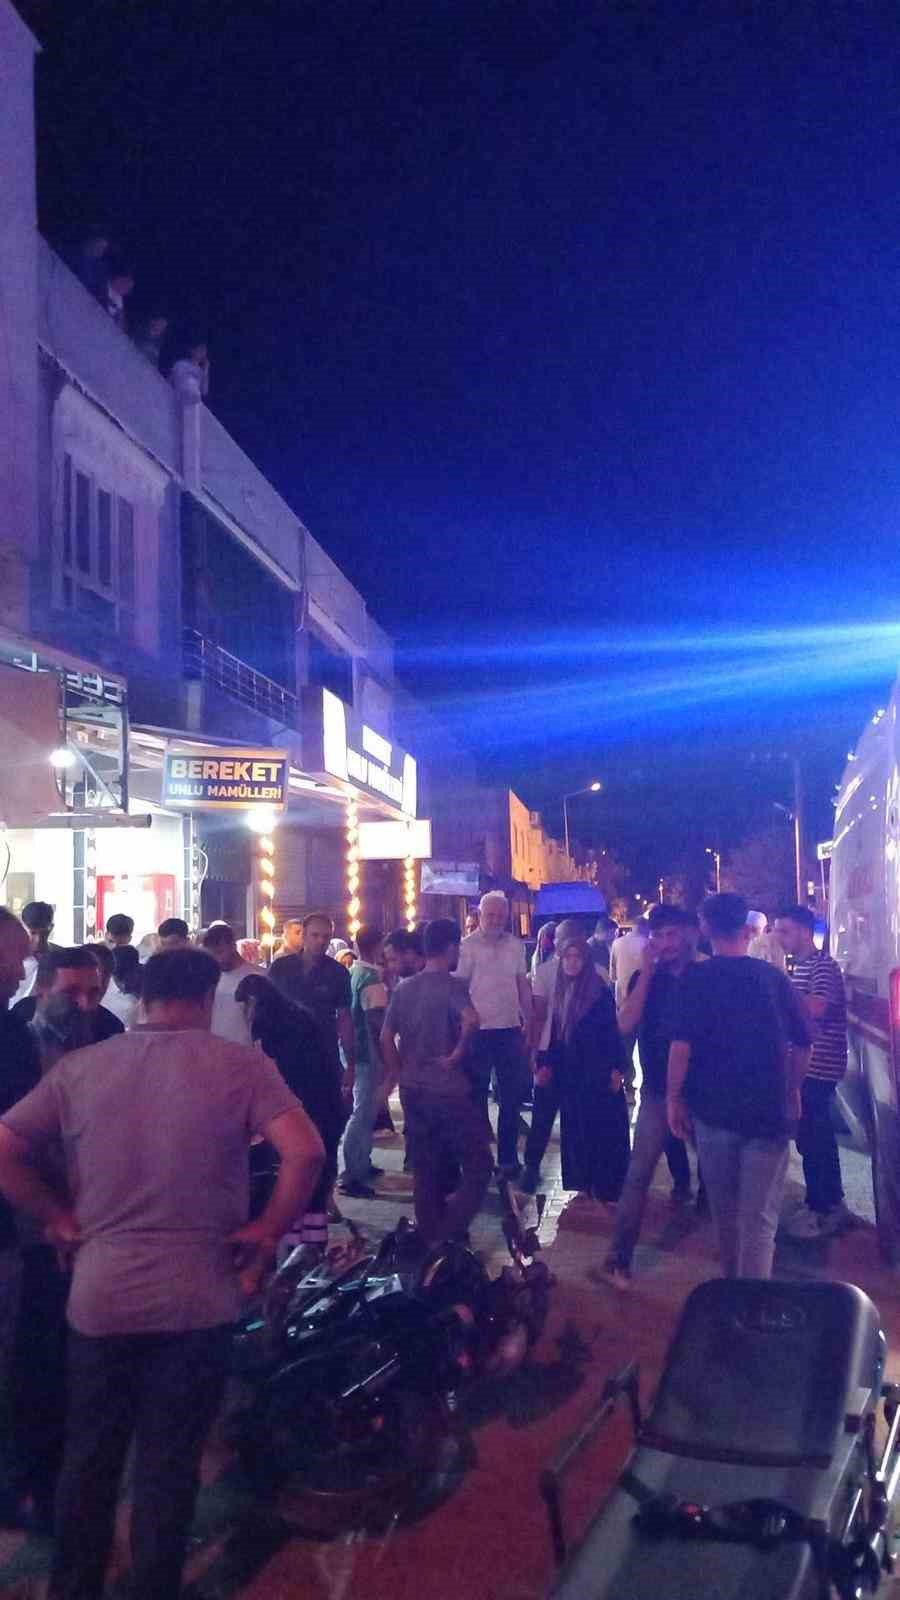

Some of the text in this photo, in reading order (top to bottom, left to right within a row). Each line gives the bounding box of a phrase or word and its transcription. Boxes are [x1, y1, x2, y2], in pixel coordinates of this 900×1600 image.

[171, 760, 282, 782] BEREKET
[169, 784, 282, 798] UNLU MAMÜLLERİ
